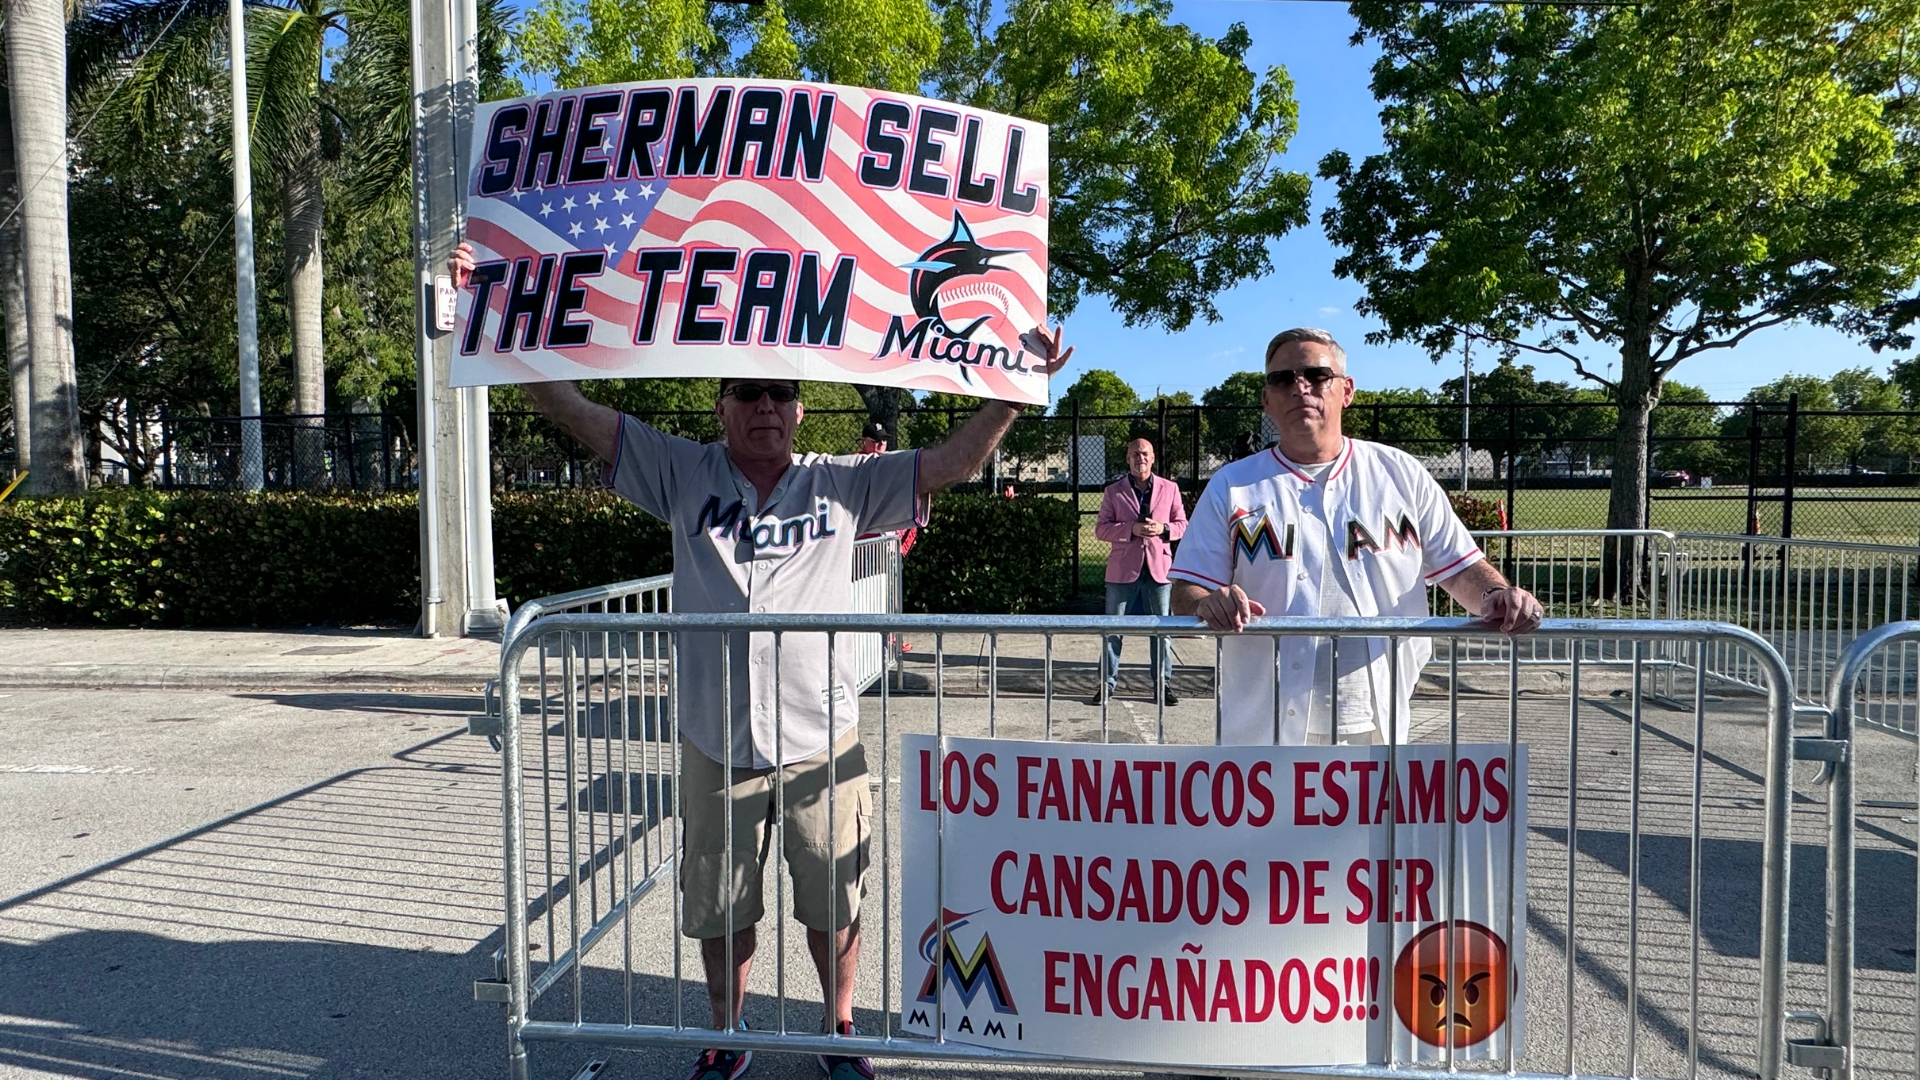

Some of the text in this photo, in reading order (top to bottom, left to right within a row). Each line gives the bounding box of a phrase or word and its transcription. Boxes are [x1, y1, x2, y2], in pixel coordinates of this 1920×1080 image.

[477, 85, 1042, 216] SHERMAN SELL
[460, 247, 858, 358] THE TEAM
[871, 313, 1029, 376] Miami
[919, 750, 1510, 828] LOS FANATICOS ESTAMOS
[990, 850, 1435, 926] CANSADOS DE SER
[1043, 942, 1381, 1023] ENGAÑADOS!!!
[908, 1008, 1023, 1041] MIAMI
